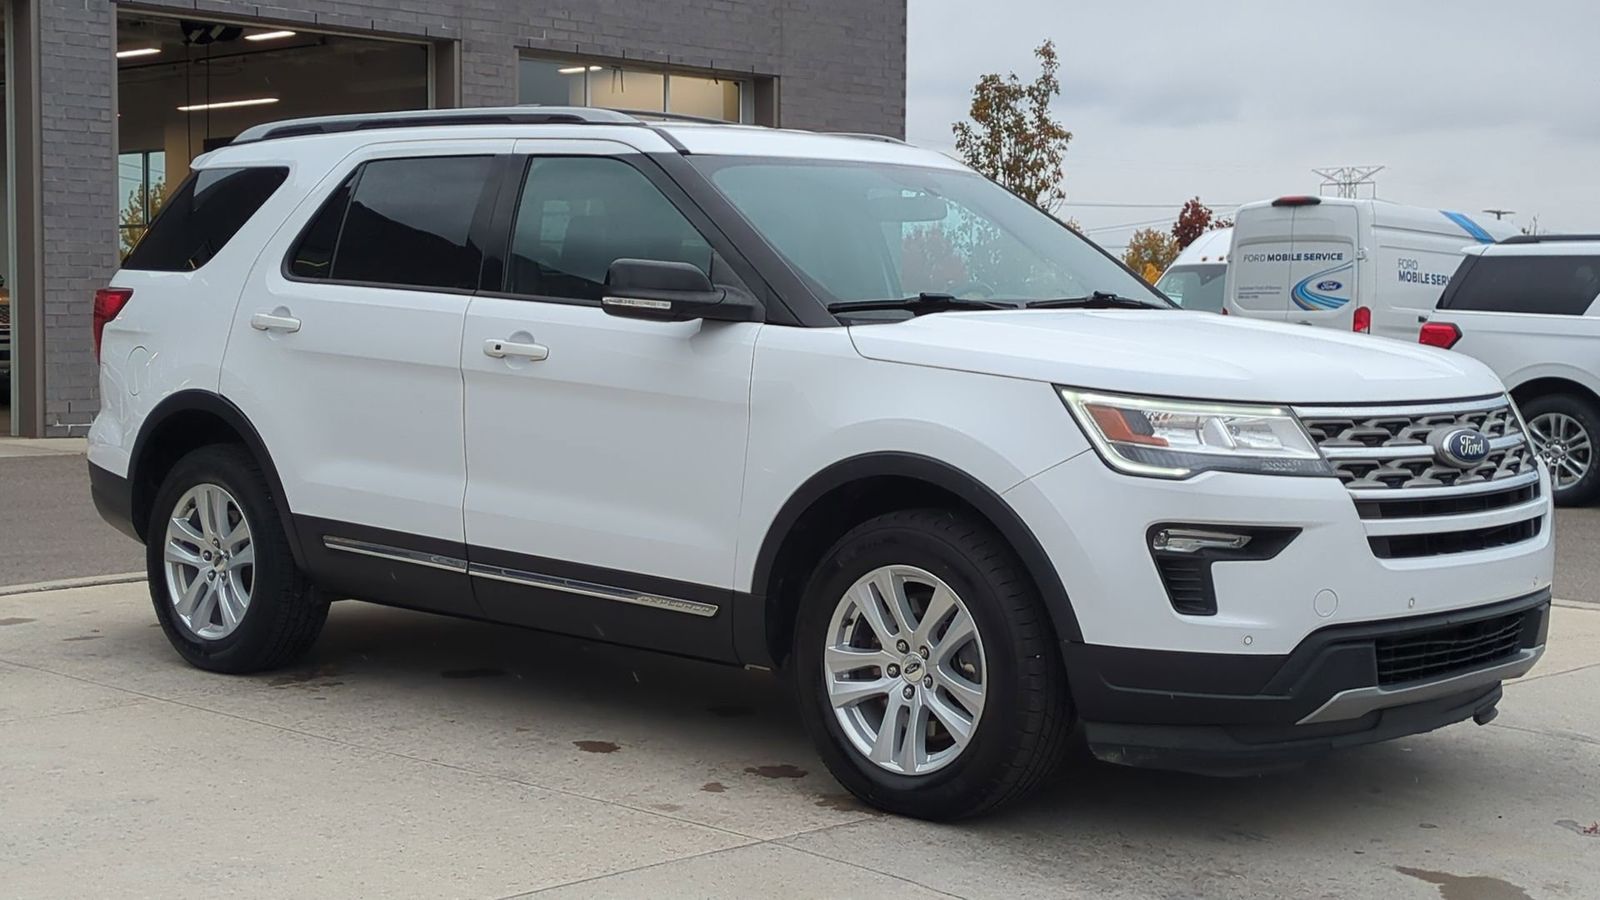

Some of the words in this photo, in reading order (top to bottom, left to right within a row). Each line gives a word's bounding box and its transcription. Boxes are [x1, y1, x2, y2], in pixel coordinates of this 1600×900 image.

[1243, 254, 1266, 263] FORD
[1267, 253, 1303, 262] MOBILE
[1304, 252, 1343, 261] SERVICE
[1398, 258, 1419, 270] FORD
[1398, 270, 1430, 285] MOBILE
[1431, 273, 1453, 286] SERV
[1460, 434, 1484, 456] Ford
